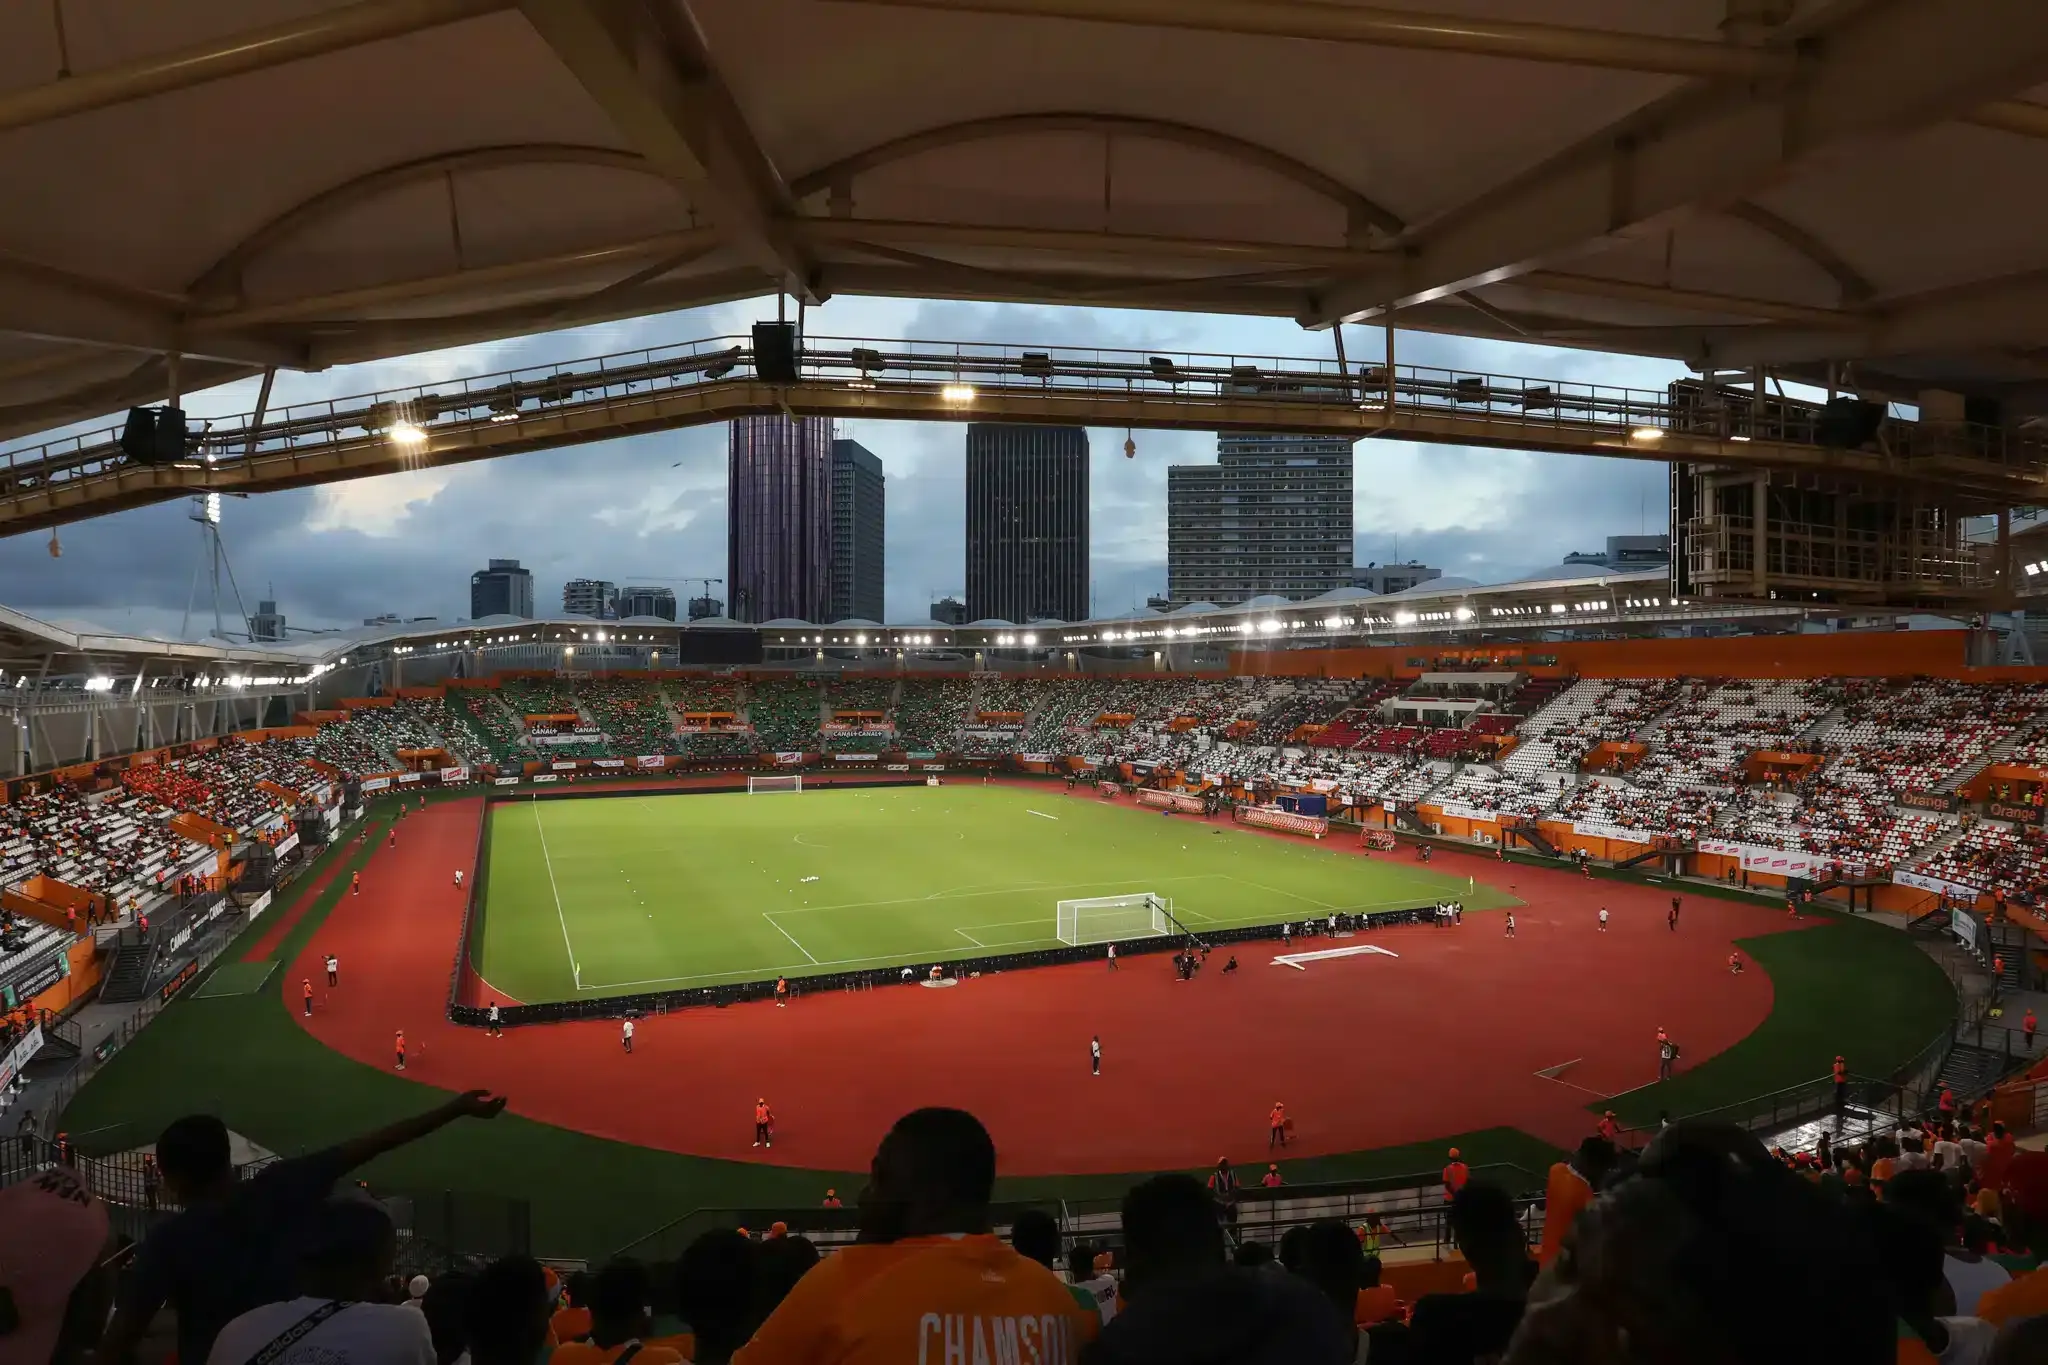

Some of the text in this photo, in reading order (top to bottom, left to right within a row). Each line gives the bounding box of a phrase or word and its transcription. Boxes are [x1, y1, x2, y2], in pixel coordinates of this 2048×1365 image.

[1902, 792, 1949, 810] Orange
[1990, 803, 2037, 821] Orange
[256, 1319, 315, 1365] adidas
